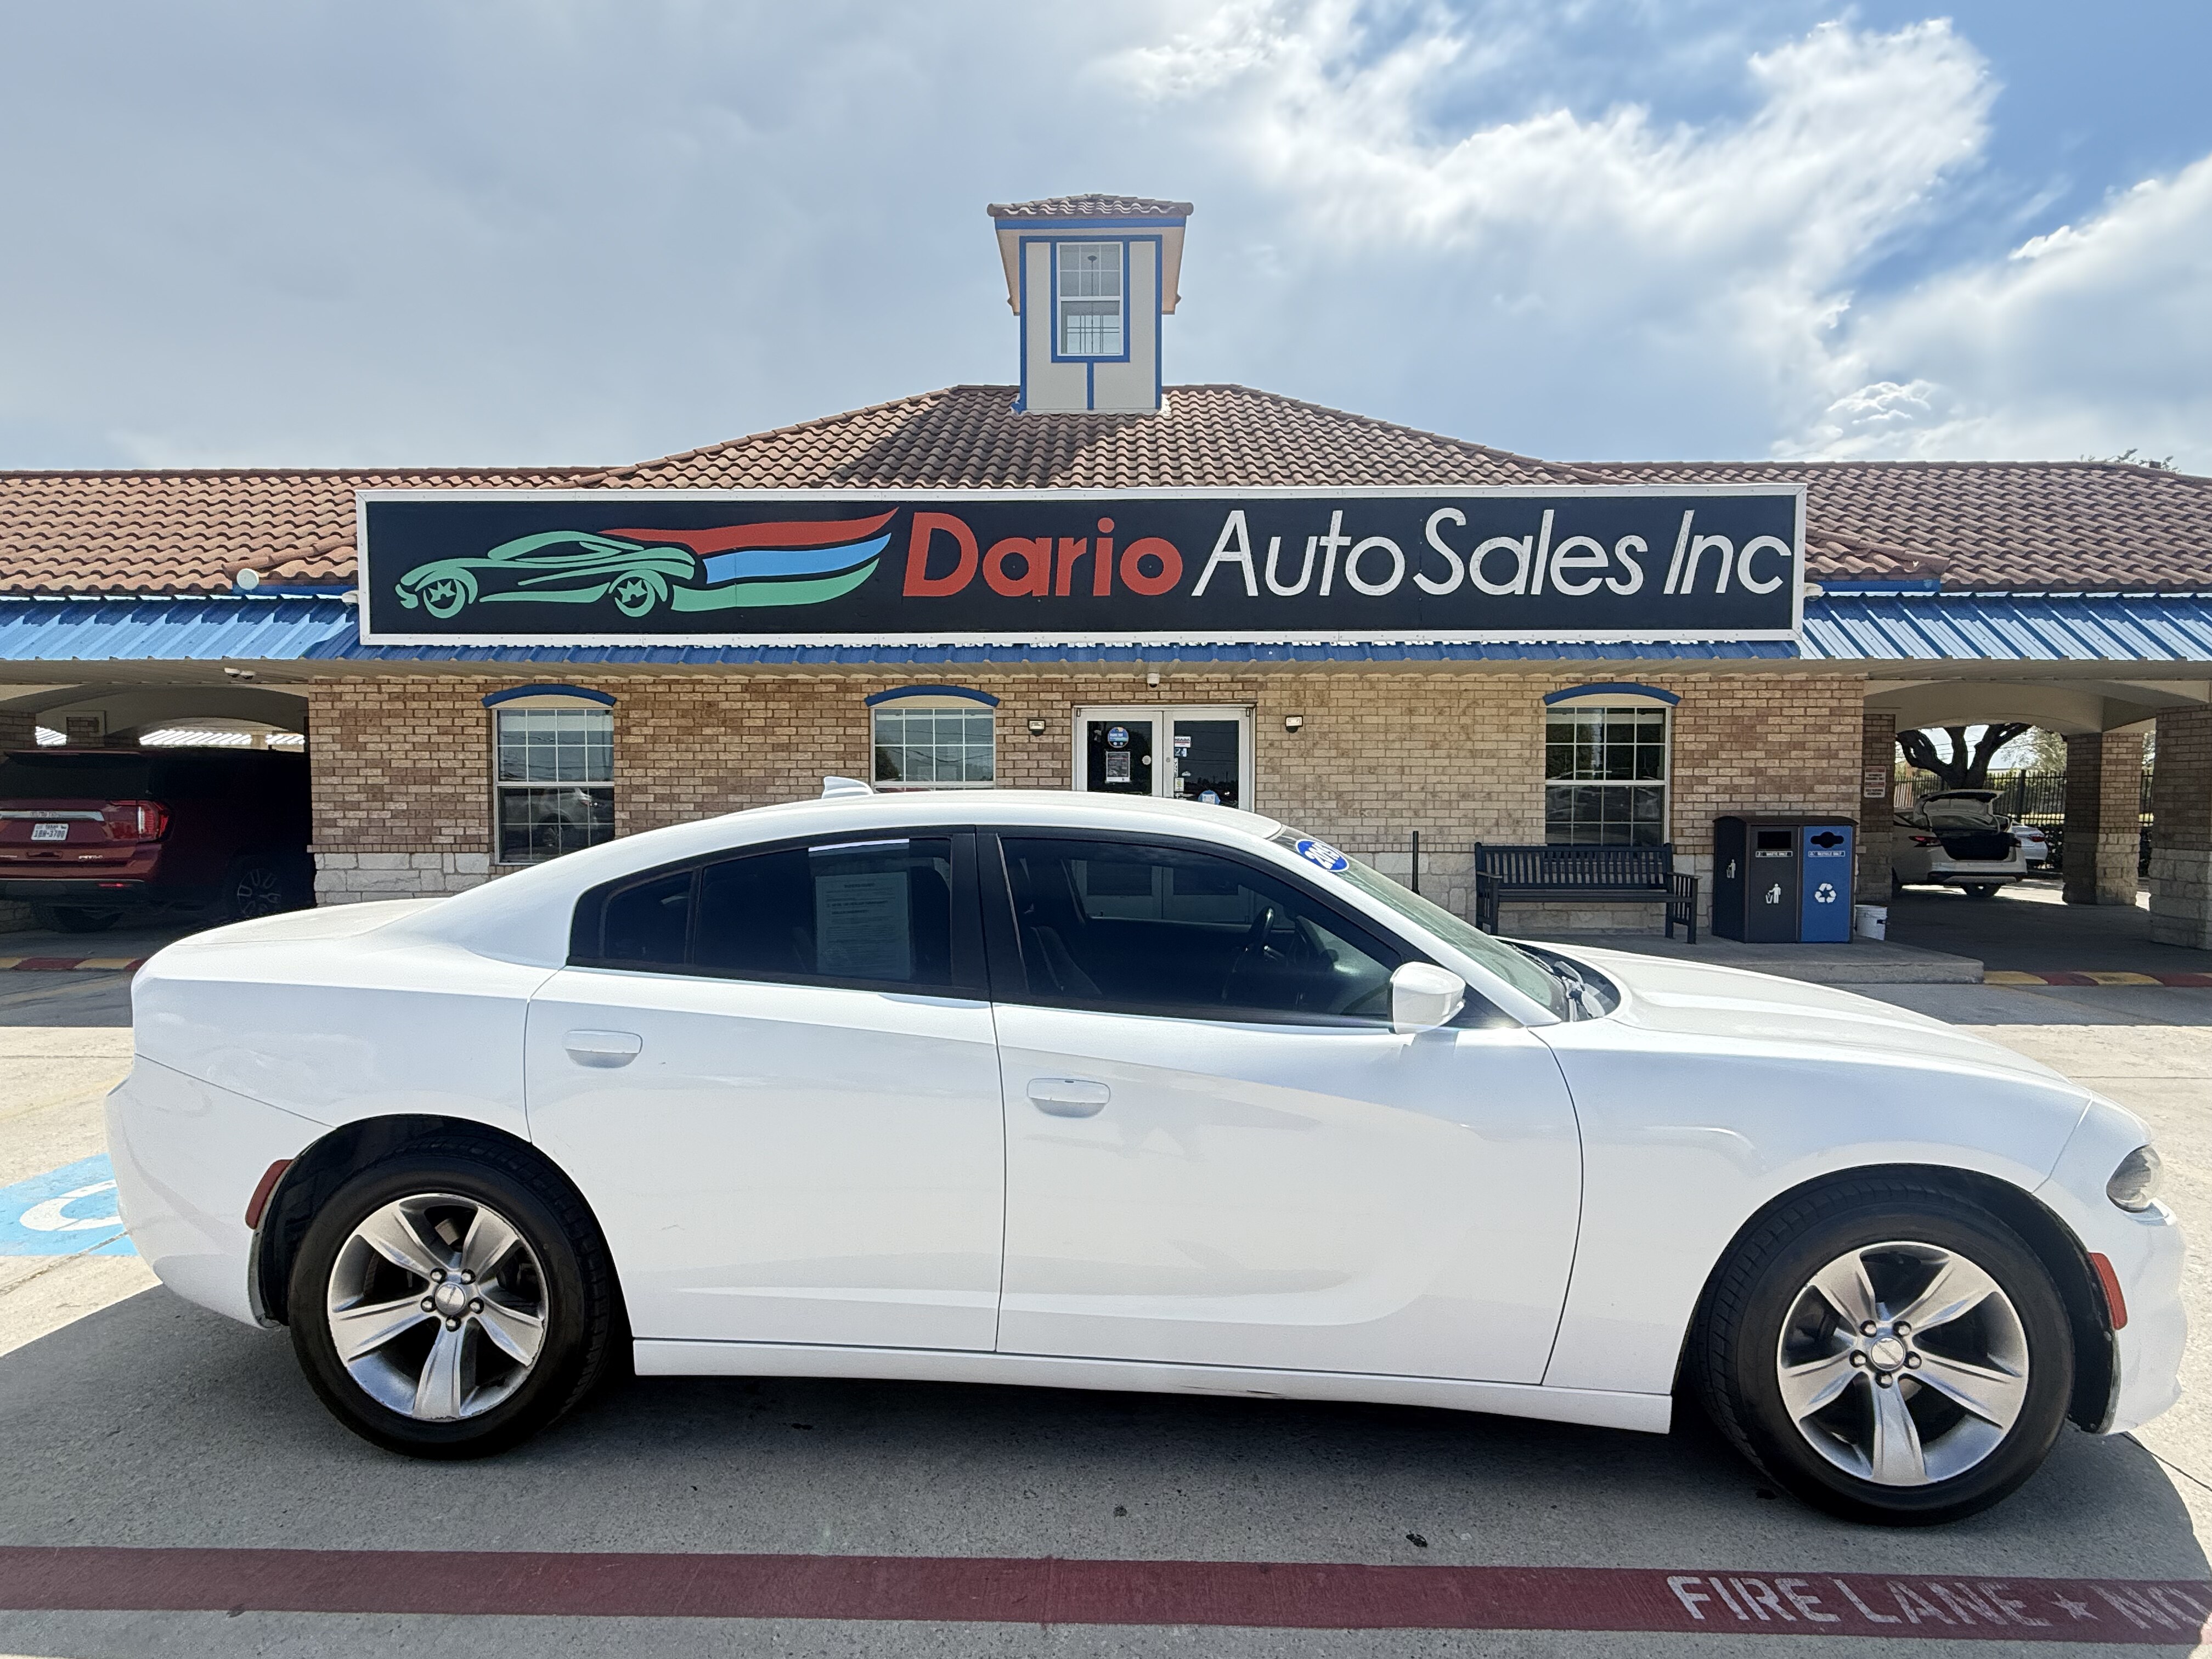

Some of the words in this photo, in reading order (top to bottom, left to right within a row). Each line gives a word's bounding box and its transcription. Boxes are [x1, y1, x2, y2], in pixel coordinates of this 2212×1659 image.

[904, 512, 1182, 596] Dario
[1191, 510, 1406, 596] Auto
[1413, 507, 1648, 596] Sales
[1663, 510, 1792, 595] Inc
[1667, 1576, 1841, 1622] FIRE
[1833, 1579, 2053, 1626] LANE
[2089, 1584, 2210, 1631] NO
